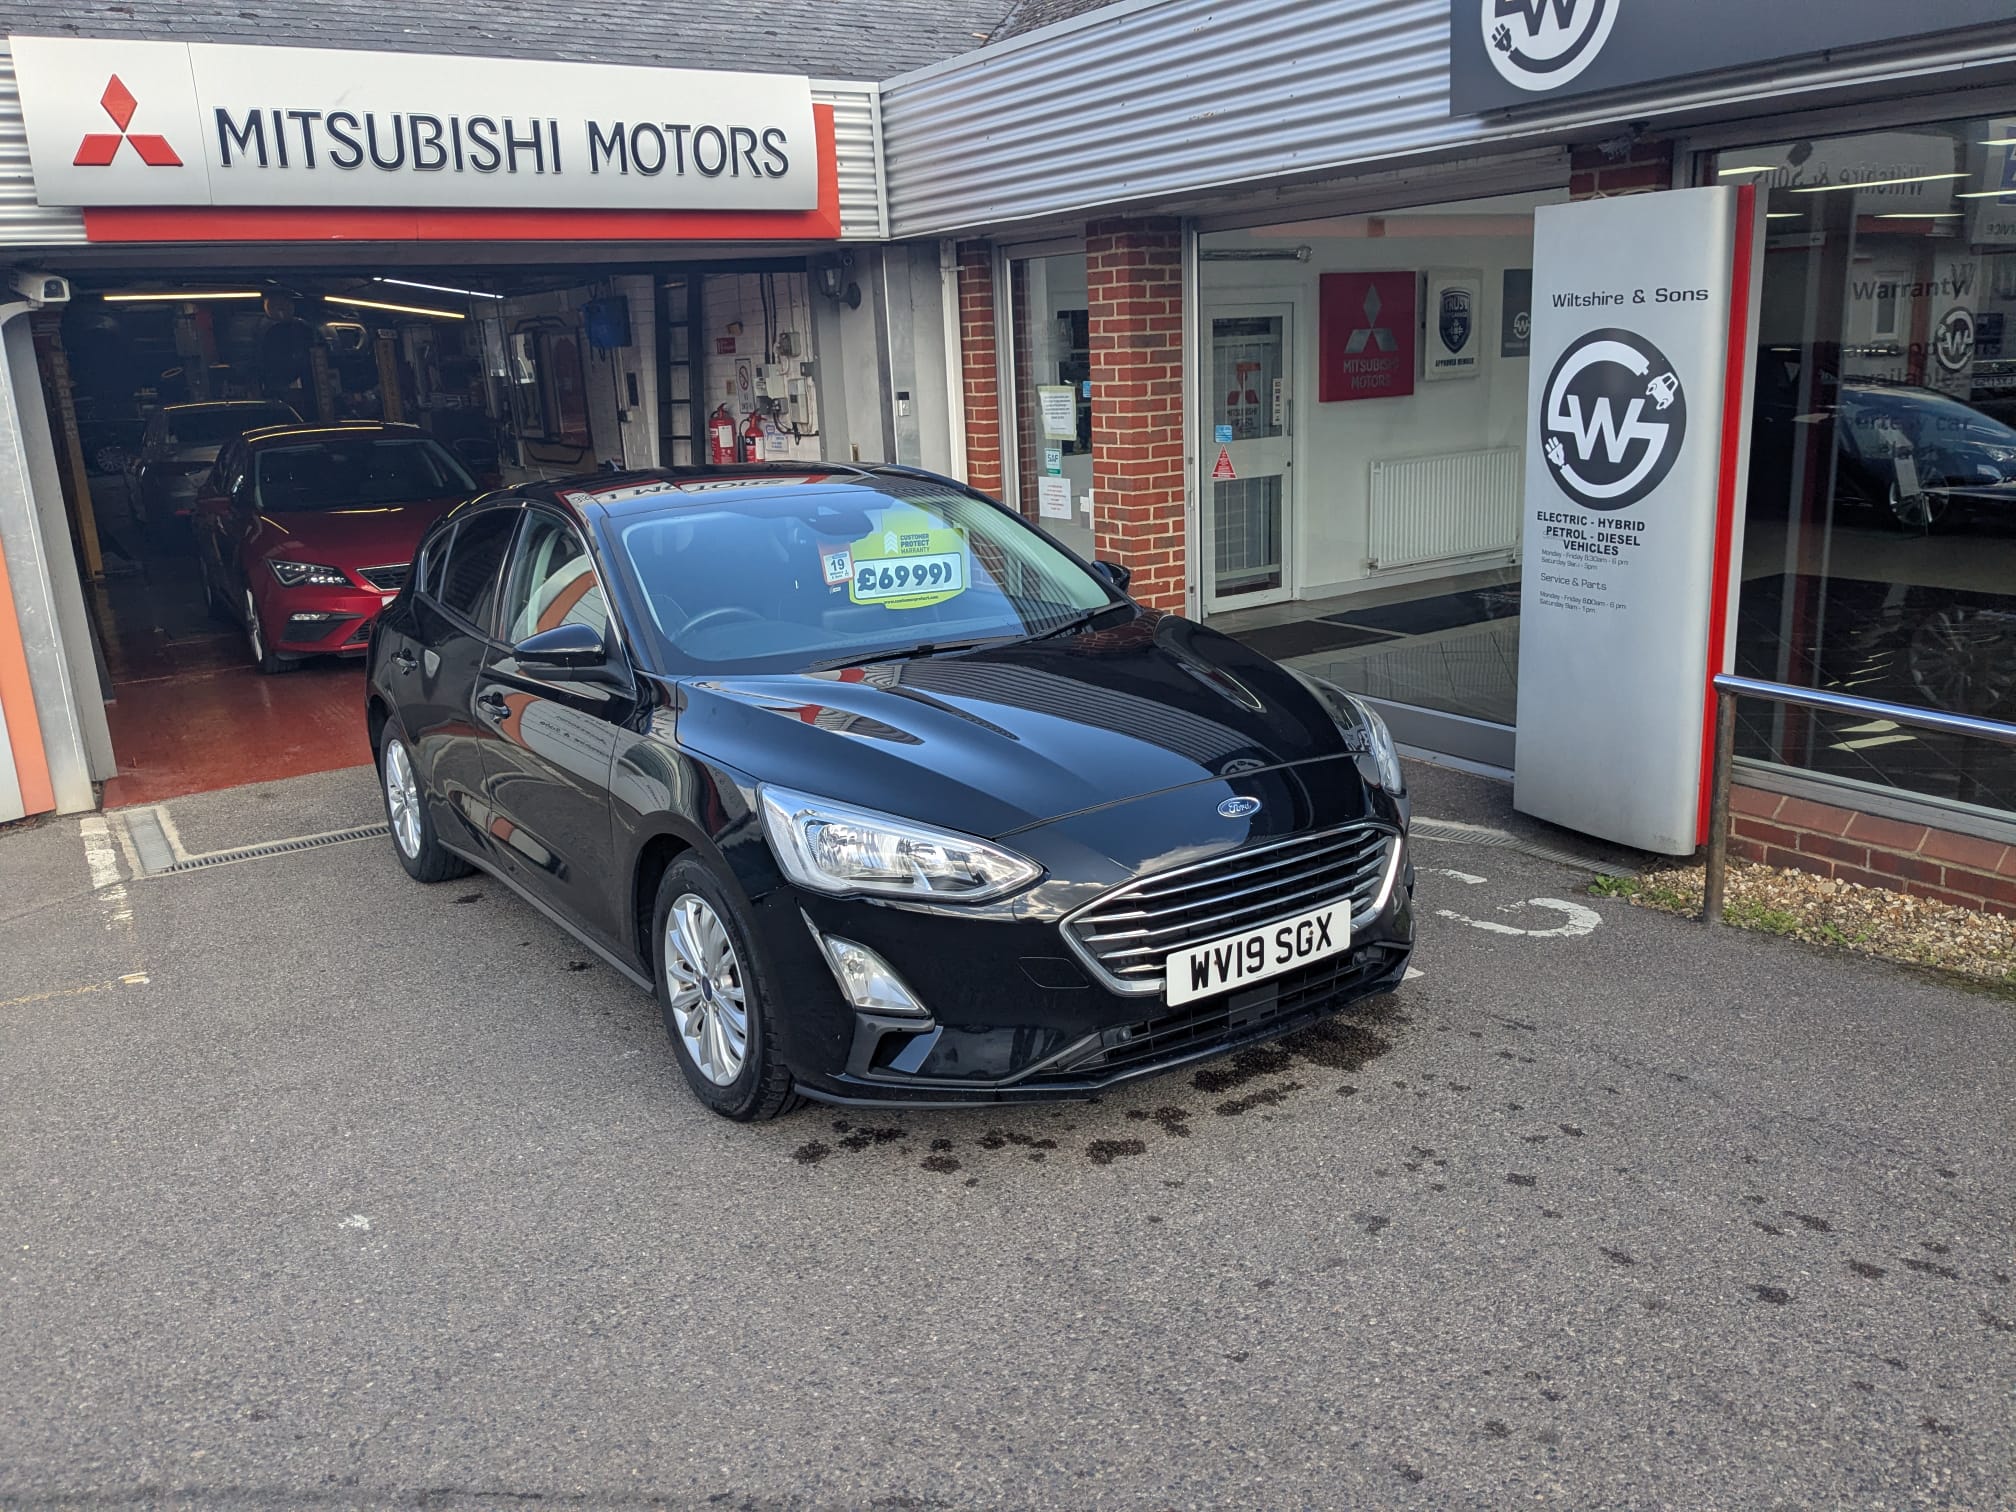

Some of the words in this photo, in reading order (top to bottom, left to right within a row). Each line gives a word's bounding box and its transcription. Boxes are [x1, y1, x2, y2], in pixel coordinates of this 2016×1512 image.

[213, 106, 563, 175] MITSUBISHI
[586, 118, 790, 179] MOTORS
[1552, 291, 1624, 308] Wiltshire
[1632, 289, 1646, 304] &
[1655, 287, 1709, 303] Sons
[1853, 278, 1966, 300] Warranty
[1537, 511, 1588, 526] ELECTRIC
[1598, 518, 1646, 532] HYBRID
[900, 533, 929, 541] CUSTOMER
[900, 540, 930, 548] PROTECT
[1546, 526, 1587, 541] PETROL
[1597, 532, 1641, 546] DIESEL
[1563, 540, 1620, 556] VEHICLES
[831, 559, 845, 571] 19
[1540, 572, 1570, 586] Service
[1572, 577, 1579, 587] &
[1581, 578, 1608, 591] Parts
[1228, 801, 1252, 814] Ford
[1190, 935, 1265, 992] WV19
[1275, 911, 1333, 965] SGX
